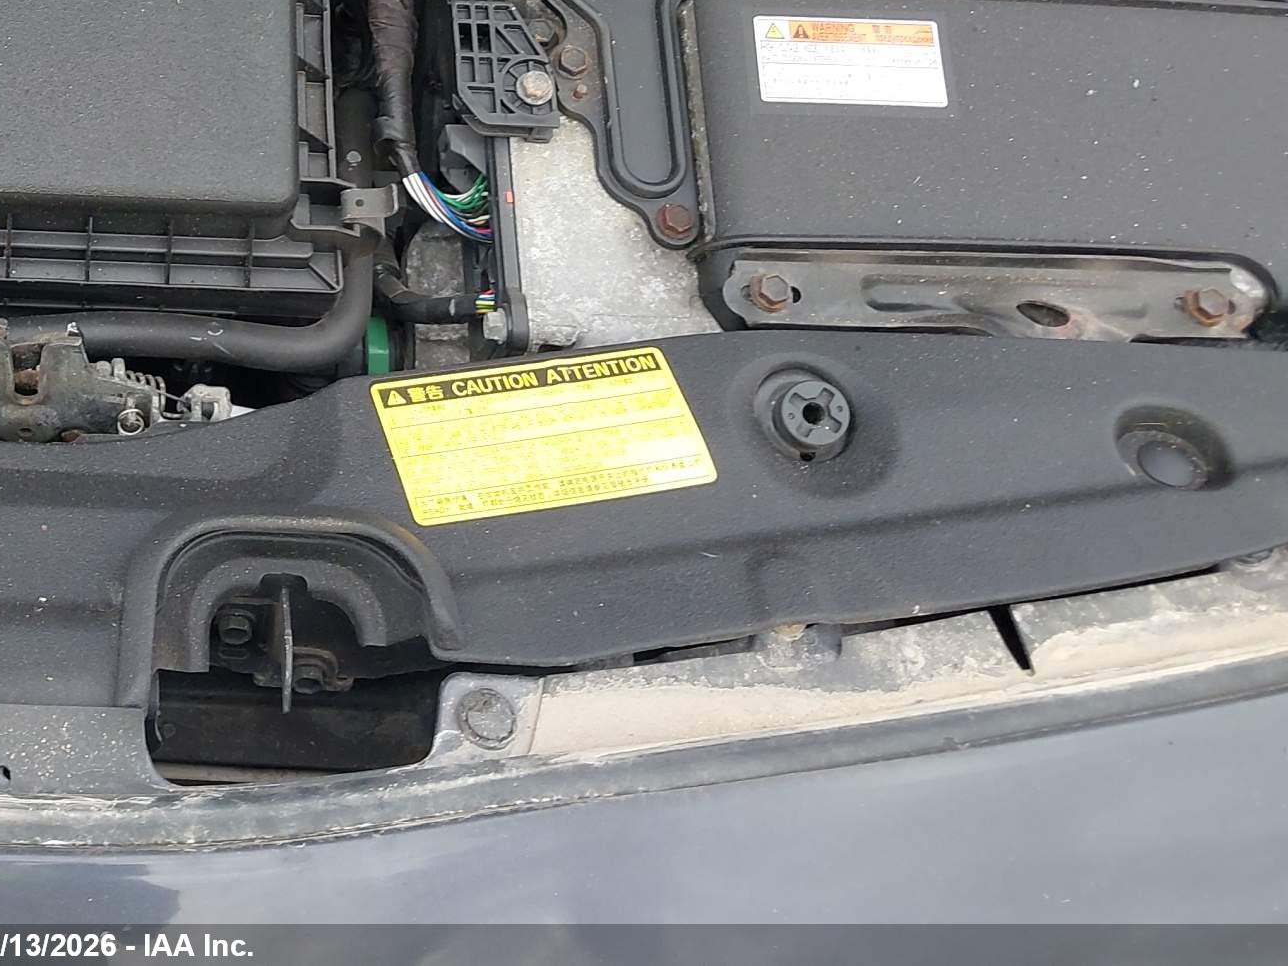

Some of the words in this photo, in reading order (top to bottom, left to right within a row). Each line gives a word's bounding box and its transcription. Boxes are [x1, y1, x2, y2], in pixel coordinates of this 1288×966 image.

[407, 386, 445, 404] 警告
[451, 371, 539, 397] CAUTION
[546, 355, 657, 384] ATTENTION
